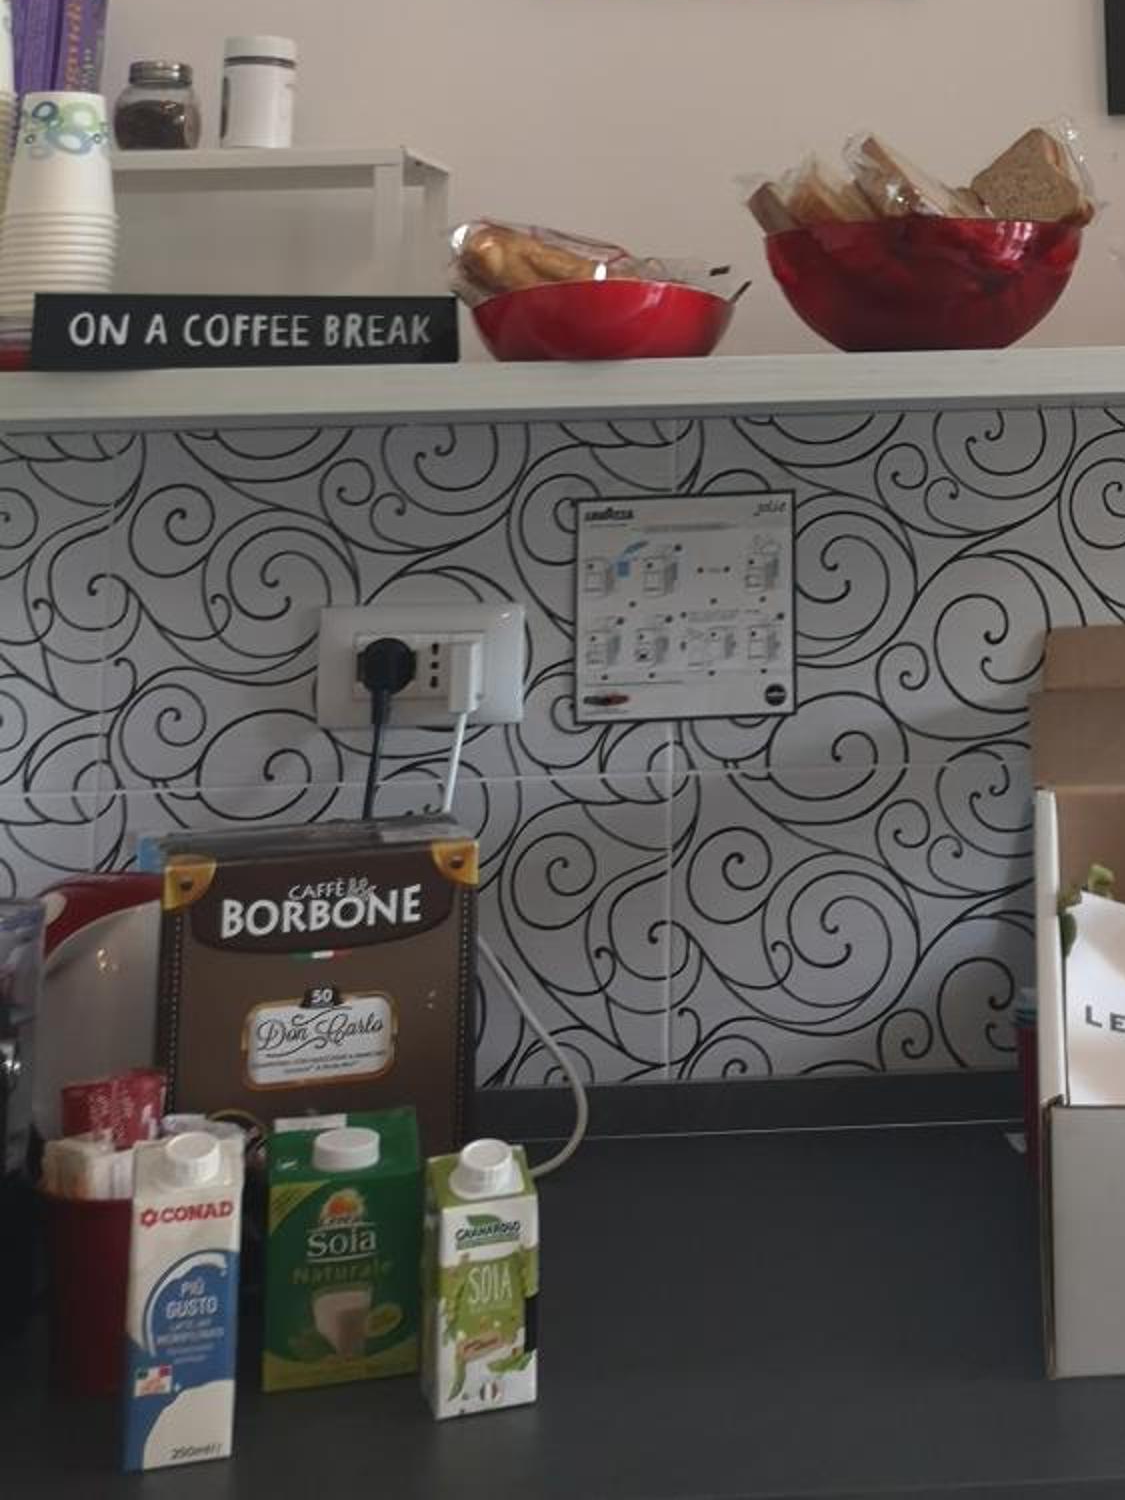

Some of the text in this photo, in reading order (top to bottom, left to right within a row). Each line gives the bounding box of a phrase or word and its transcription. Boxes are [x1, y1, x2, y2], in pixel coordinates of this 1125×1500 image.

[68, 311, 432, 348] ON A COFFEE BREAK
[288, 877, 345, 901] CAFFÈ
[221, 883, 422, 940] BORBONE
[311, 988, 334, 1003] 50
[256, 1019, 309, 1050] Don
[160, 1201, 234, 1224] CONAD
[306, 1226, 377, 1257] Soia
[468, 1265, 513, 1304] SOIA
[165, 1296, 219, 1320] GUSTO
